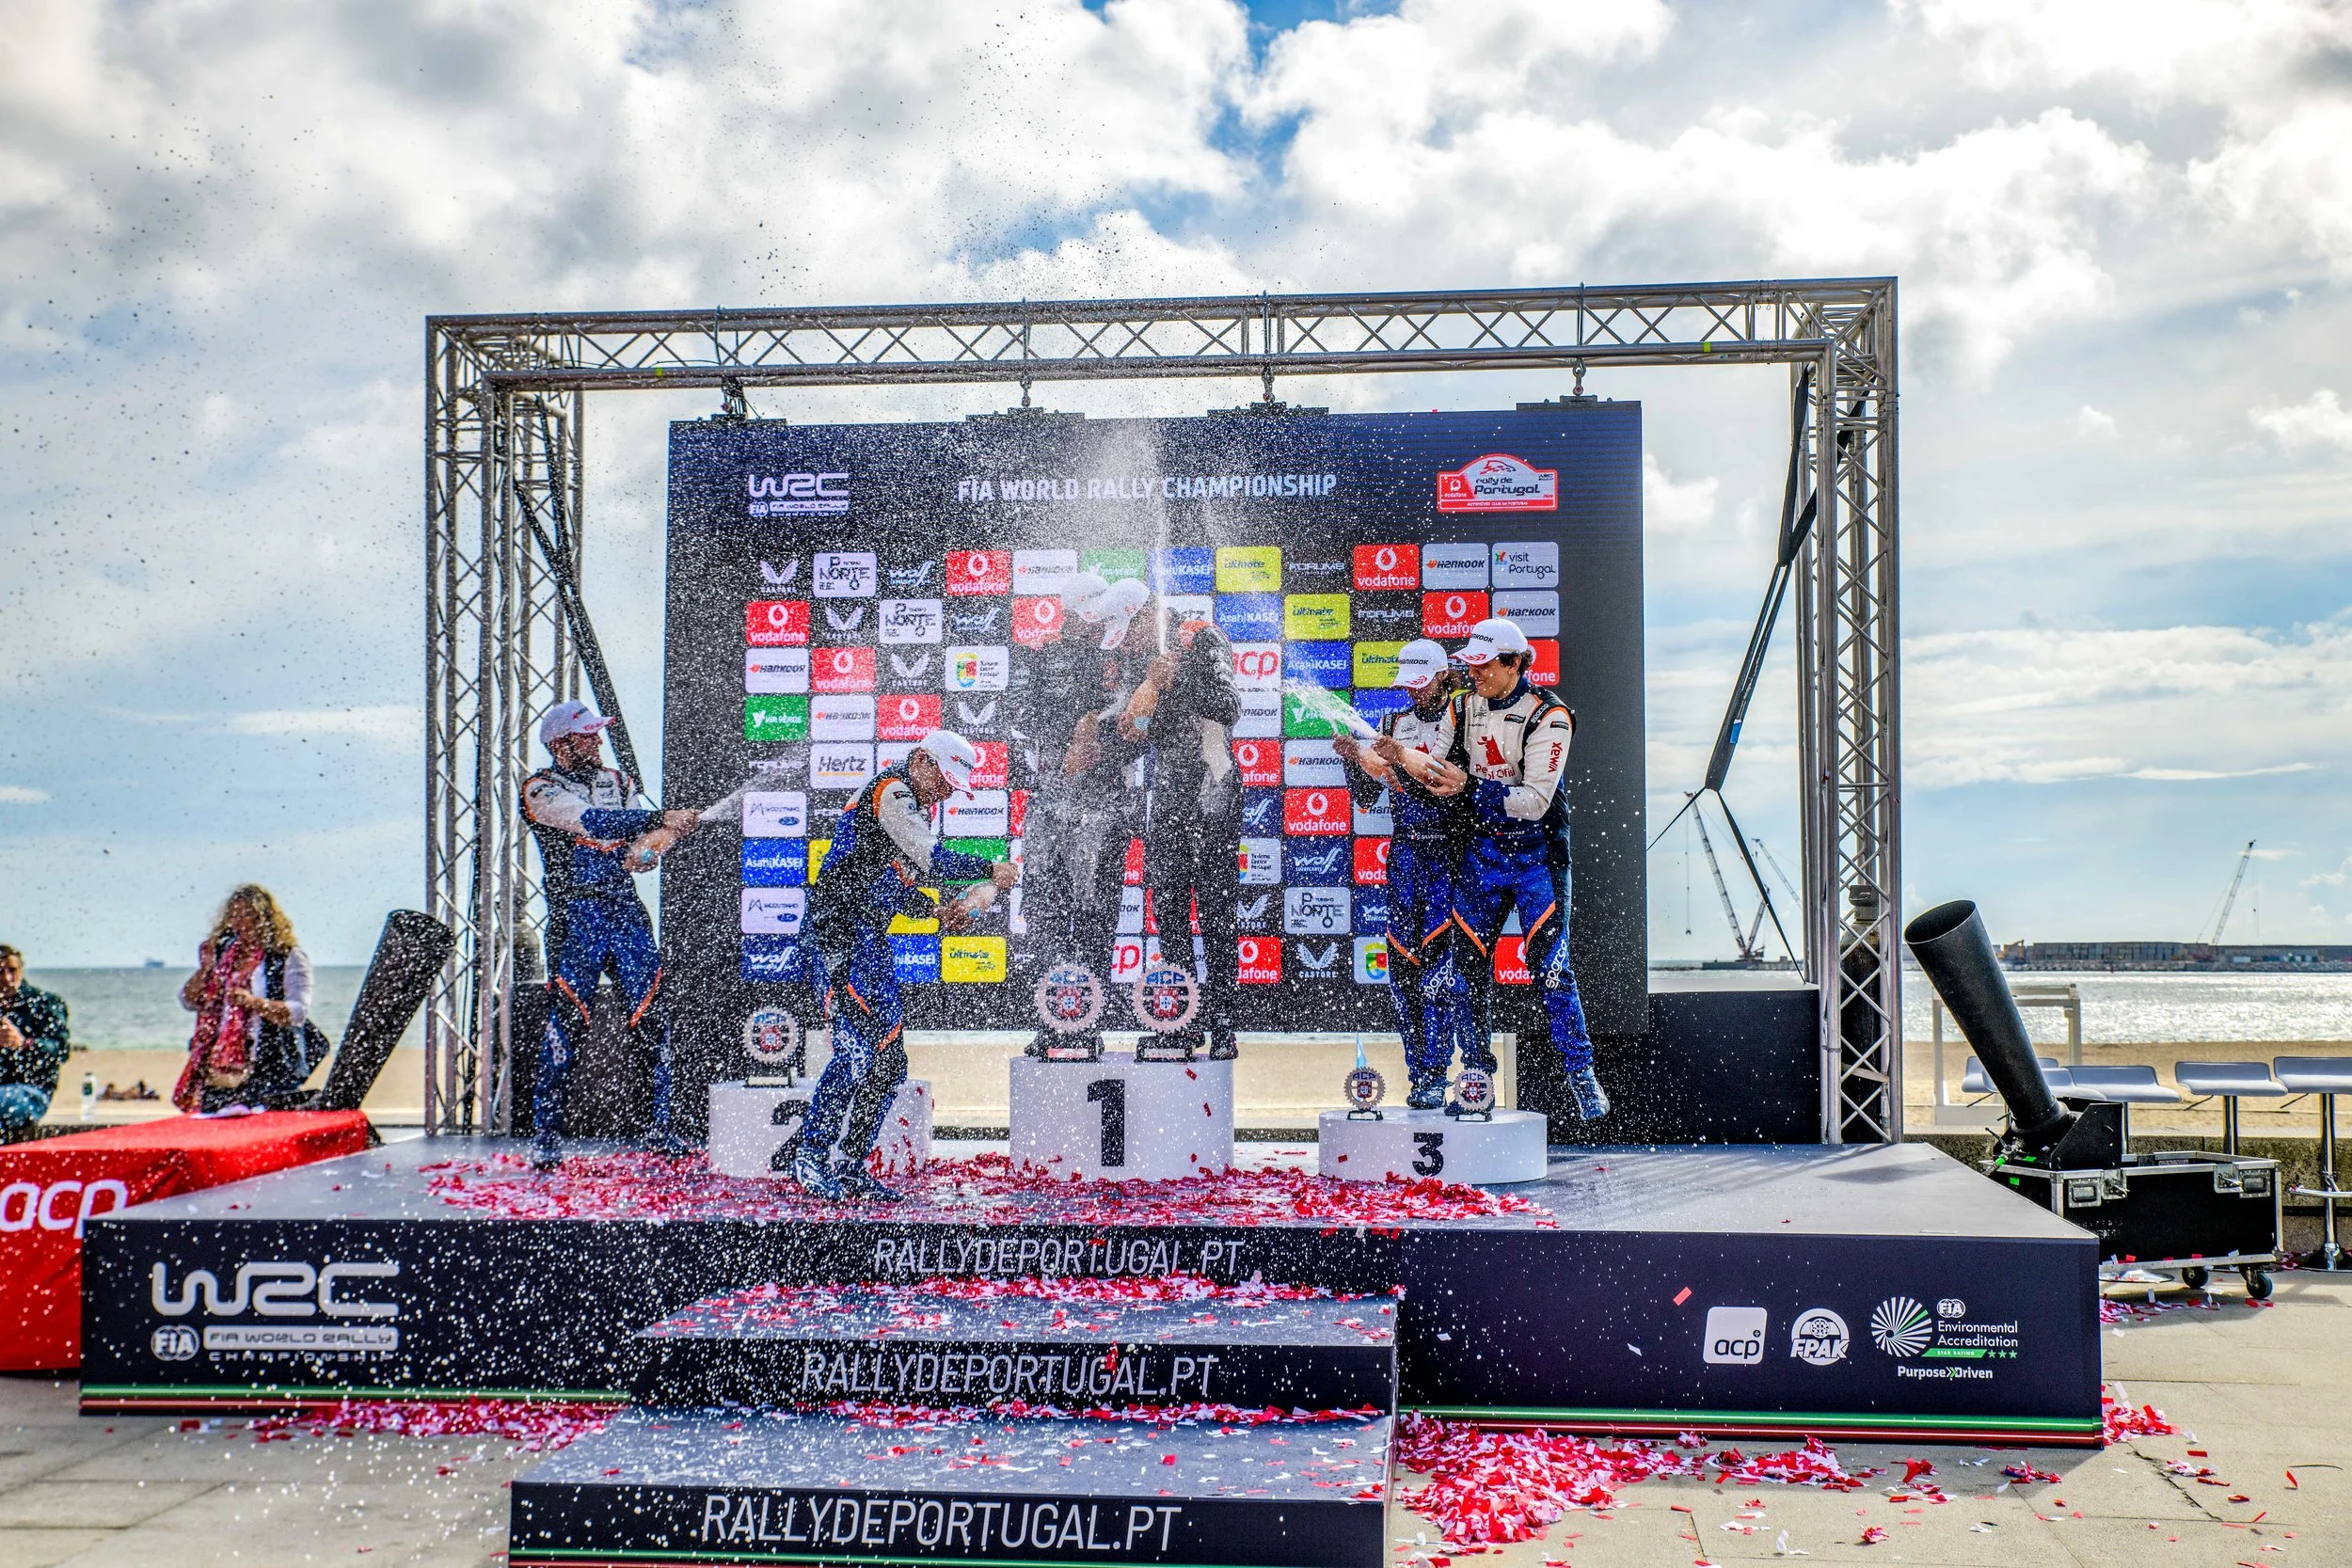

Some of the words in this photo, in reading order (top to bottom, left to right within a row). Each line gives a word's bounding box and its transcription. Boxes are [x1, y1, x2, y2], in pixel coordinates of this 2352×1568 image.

[749, 472, 849, 499] WRC
[958, 479, 995, 502] FIA
[1000, 478, 1080, 501] WORLD
[1088, 477, 1155, 499] RALLY
[1163, 474, 1337, 498] CHAMPIONSHIP
[1475, 477, 1499, 485] rally
[1474, 484, 1540, 496] Portugal
[1508, 552, 1529, 562] visit
[1508, 564, 1555, 579] Portugal
[1358, 575, 1416, 587] vodafone
[750, 628, 806, 641] vodafone
[1427, 623, 1474, 635] vodafo
[1527, 671, 1556, 684] fone
[818, 756, 866, 771] Hertz
[970, 772, 1004, 784] afone
[1242, 770, 1278, 783] afone
[1289, 818, 1346, 832] vodafone
[1359, 868, 1387, 880] voda
[895, 953, 936, 964] hiKASEI
[1146, 970, 1185, 985] ACP
[1499, 968, 1530, 980] voda
[1352, 1071, 1376, 1081] ACP
[1461, 1072, 1485, 1082] ACP
[1088, 1079, 1124, 1166] 1
[771, 1100, 811, 1171] 2
[1412, 1132, 1444, 1177] 3
[0, 1180, 129, 1240] acp
[874, 1238, 1246, 1275] RALLYDEPORTUGAL.PT
[151, 1261, 400, 1317] WRC
[1938, 1302, 1963, 1315] FIA
[1938, 1320, 2018, 1334] Environmental
[153, 1331, 196, 1355] FIA
[209, 1333, 239, 1343] FIA
[245, 1333, 316, 1344] WORLD
[323, 1333, 391, 1344] RALLY
[1937, 1334, 2018, 1347] Accreditation
[1714, 1338, 1760, 1359] acp
[1790, 1338, 1851, 1359] FPAK
[208, 1352, 391, 1362] CHAMPIONSHIP
[802, 1352, 1219, 1398] RALLYDEPORTUGAL.PT
[1898, 1365, 1947, 1380] Purpose
[1954, 1367, 1994, 1379] Driven
[701, 1494, 1183, 1552] RALLYDEPORTUGAL.PT
